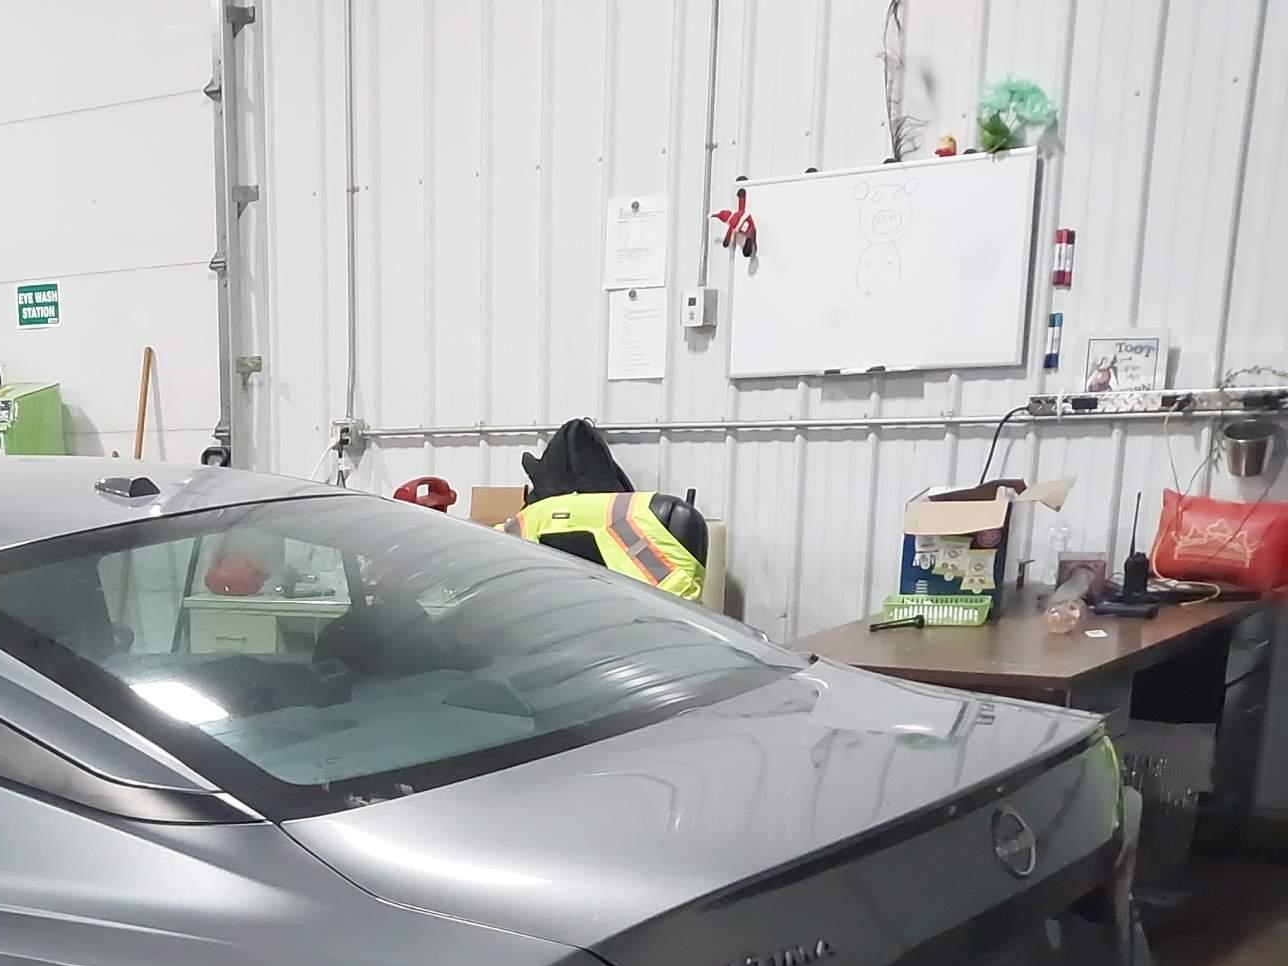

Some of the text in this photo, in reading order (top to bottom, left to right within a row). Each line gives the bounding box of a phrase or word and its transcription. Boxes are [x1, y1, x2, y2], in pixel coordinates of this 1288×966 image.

[18, 290, 58, 304] EYE WASH
[22, 305, 55, 319] STATION
[1116, 342, 1155, 358] TOOT
